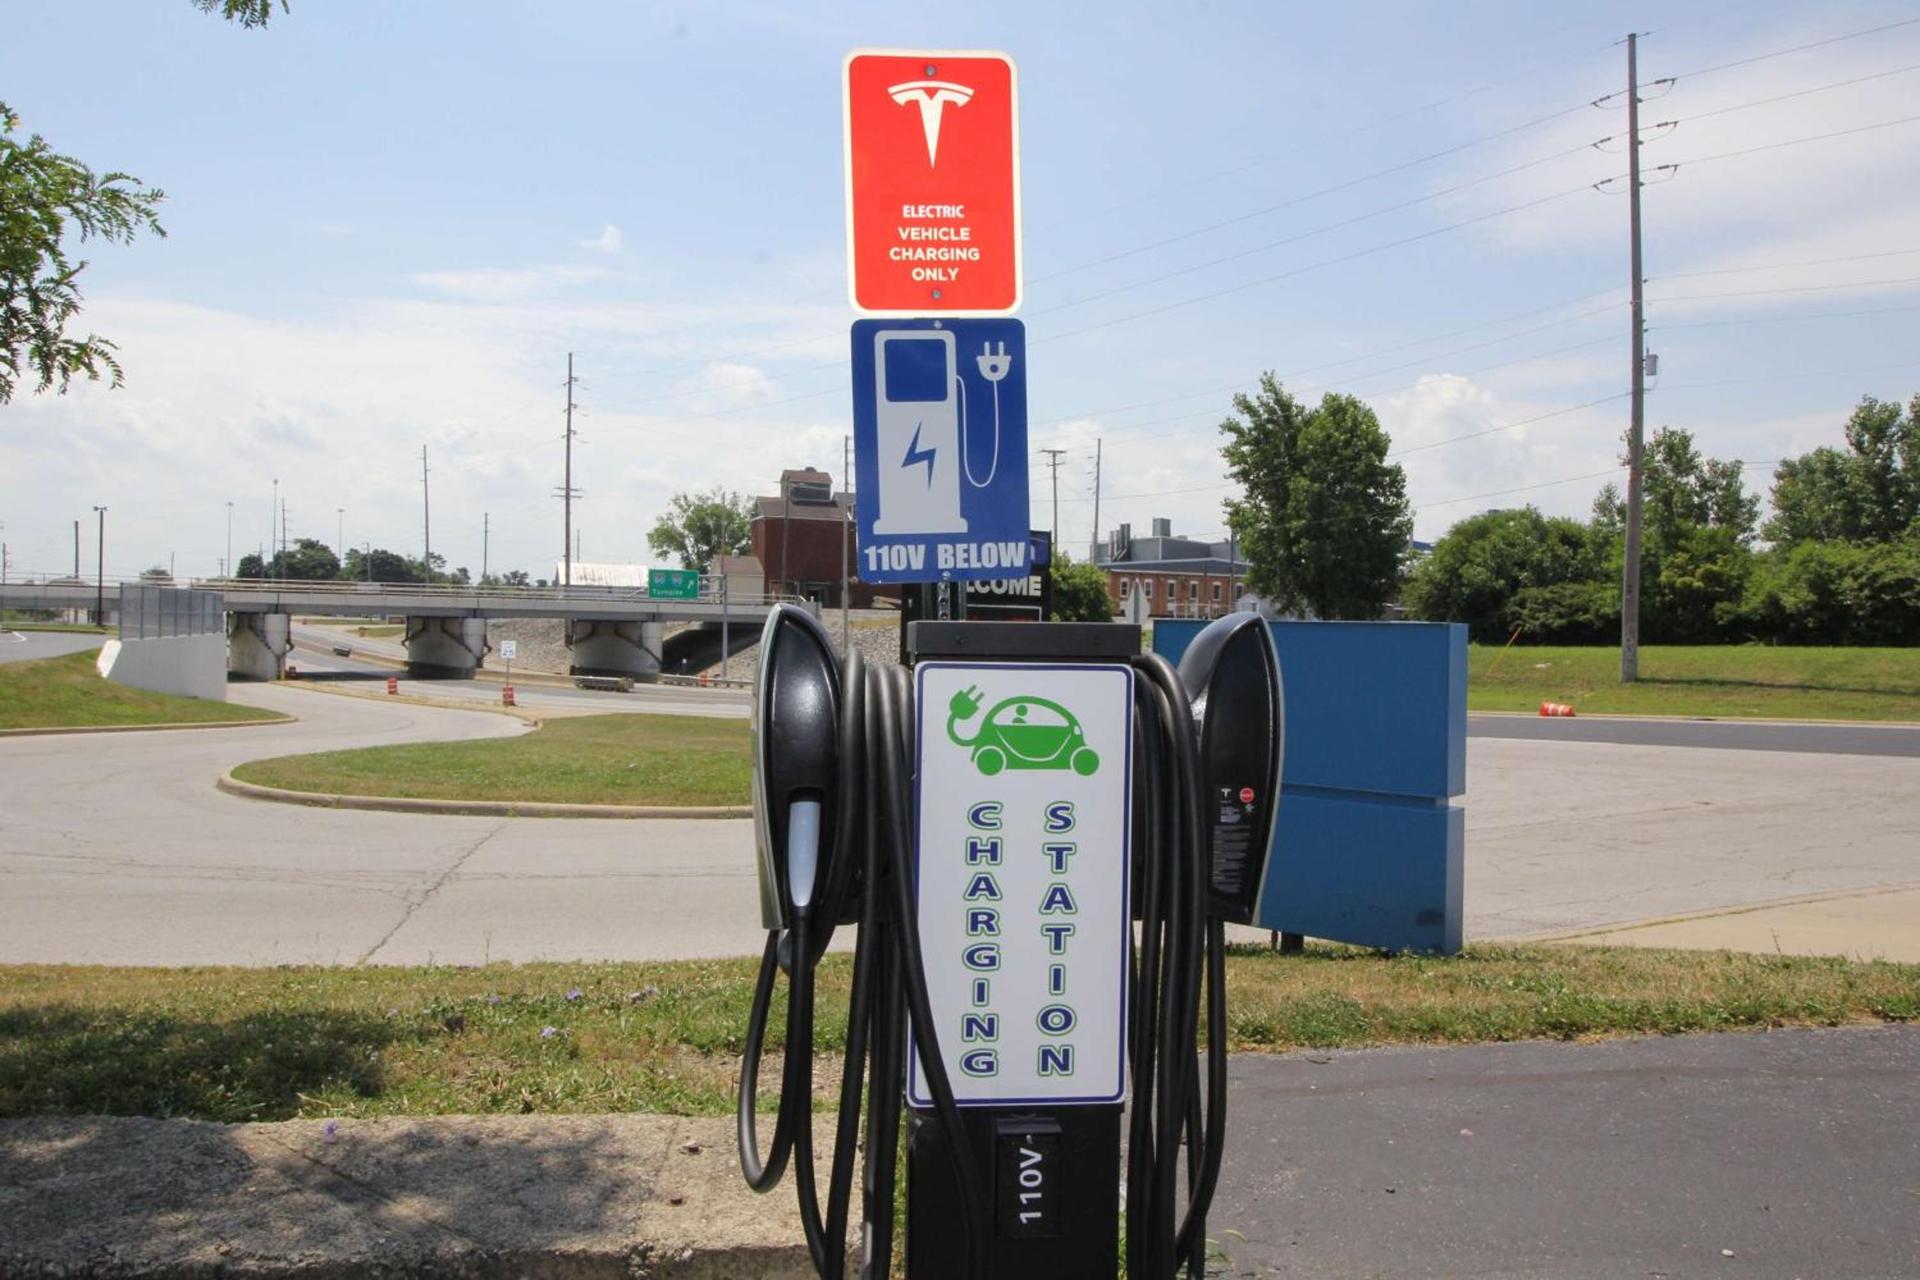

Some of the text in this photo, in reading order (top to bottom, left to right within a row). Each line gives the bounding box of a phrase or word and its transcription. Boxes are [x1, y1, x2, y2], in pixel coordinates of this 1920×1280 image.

[902, 204, 964, 218] ELECTRIC
[898, 227, 971, 241] VEHICLE
[889, 247, 980, 261] CHARGING
[912, 267, 959, 281] ONLY
[864, 544, 926, 571] 110V
[937, 541, 1026, 569] BELOW
[960, 801, 1003, 1078] CHARGING
[1037, 801, 1077, 1077] STATION
[1019, 1147, 1042, 1224] 110V
